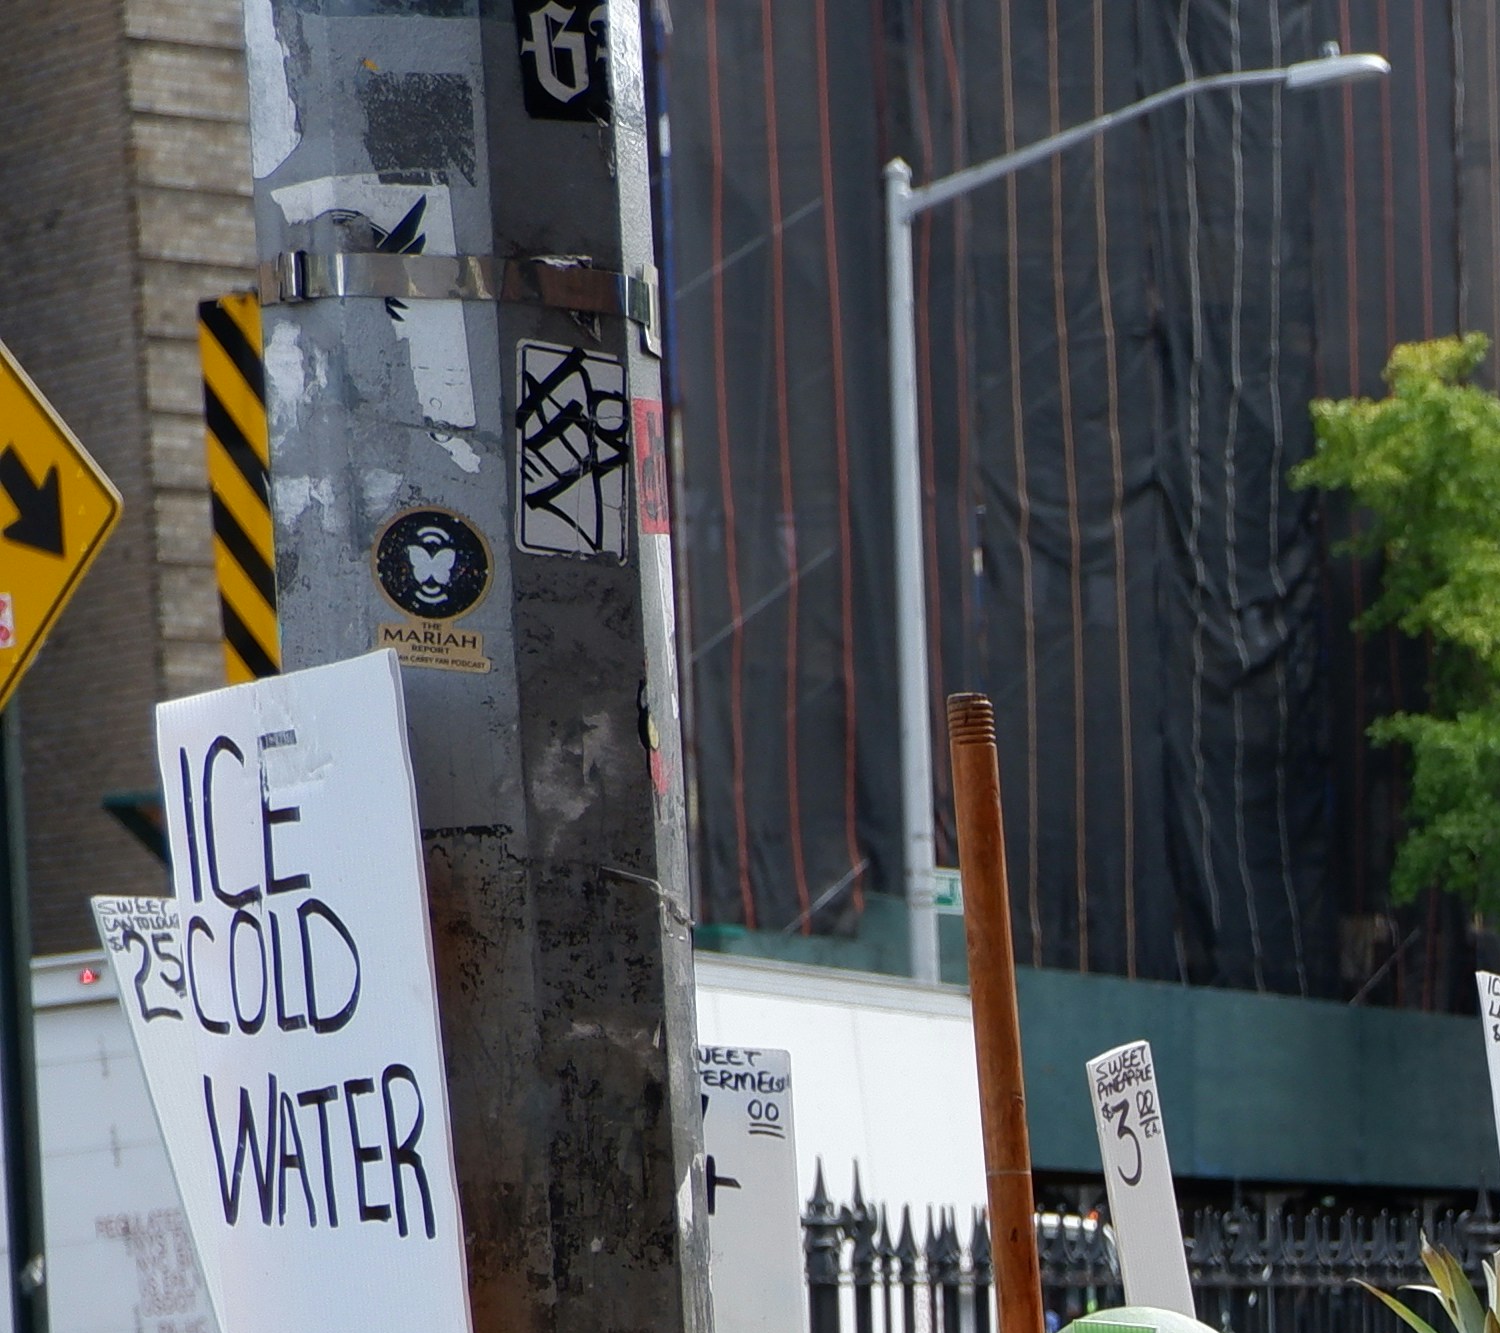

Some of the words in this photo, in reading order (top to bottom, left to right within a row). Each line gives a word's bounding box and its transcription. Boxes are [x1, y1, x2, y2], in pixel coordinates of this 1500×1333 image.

[383, 627, 478, 649] MARIAH
[422, 621, 442, 631] THE
[411, 644, 449, 655] REPORT
[450, 659, 486, 669] PODCAST
[179, 734, 311, 906] ICE
[185, 897, 362, 1036] COLD
[1095, 1045, 1148, 1083] SWEET
[203, 1062, 439, 1240] WATER
